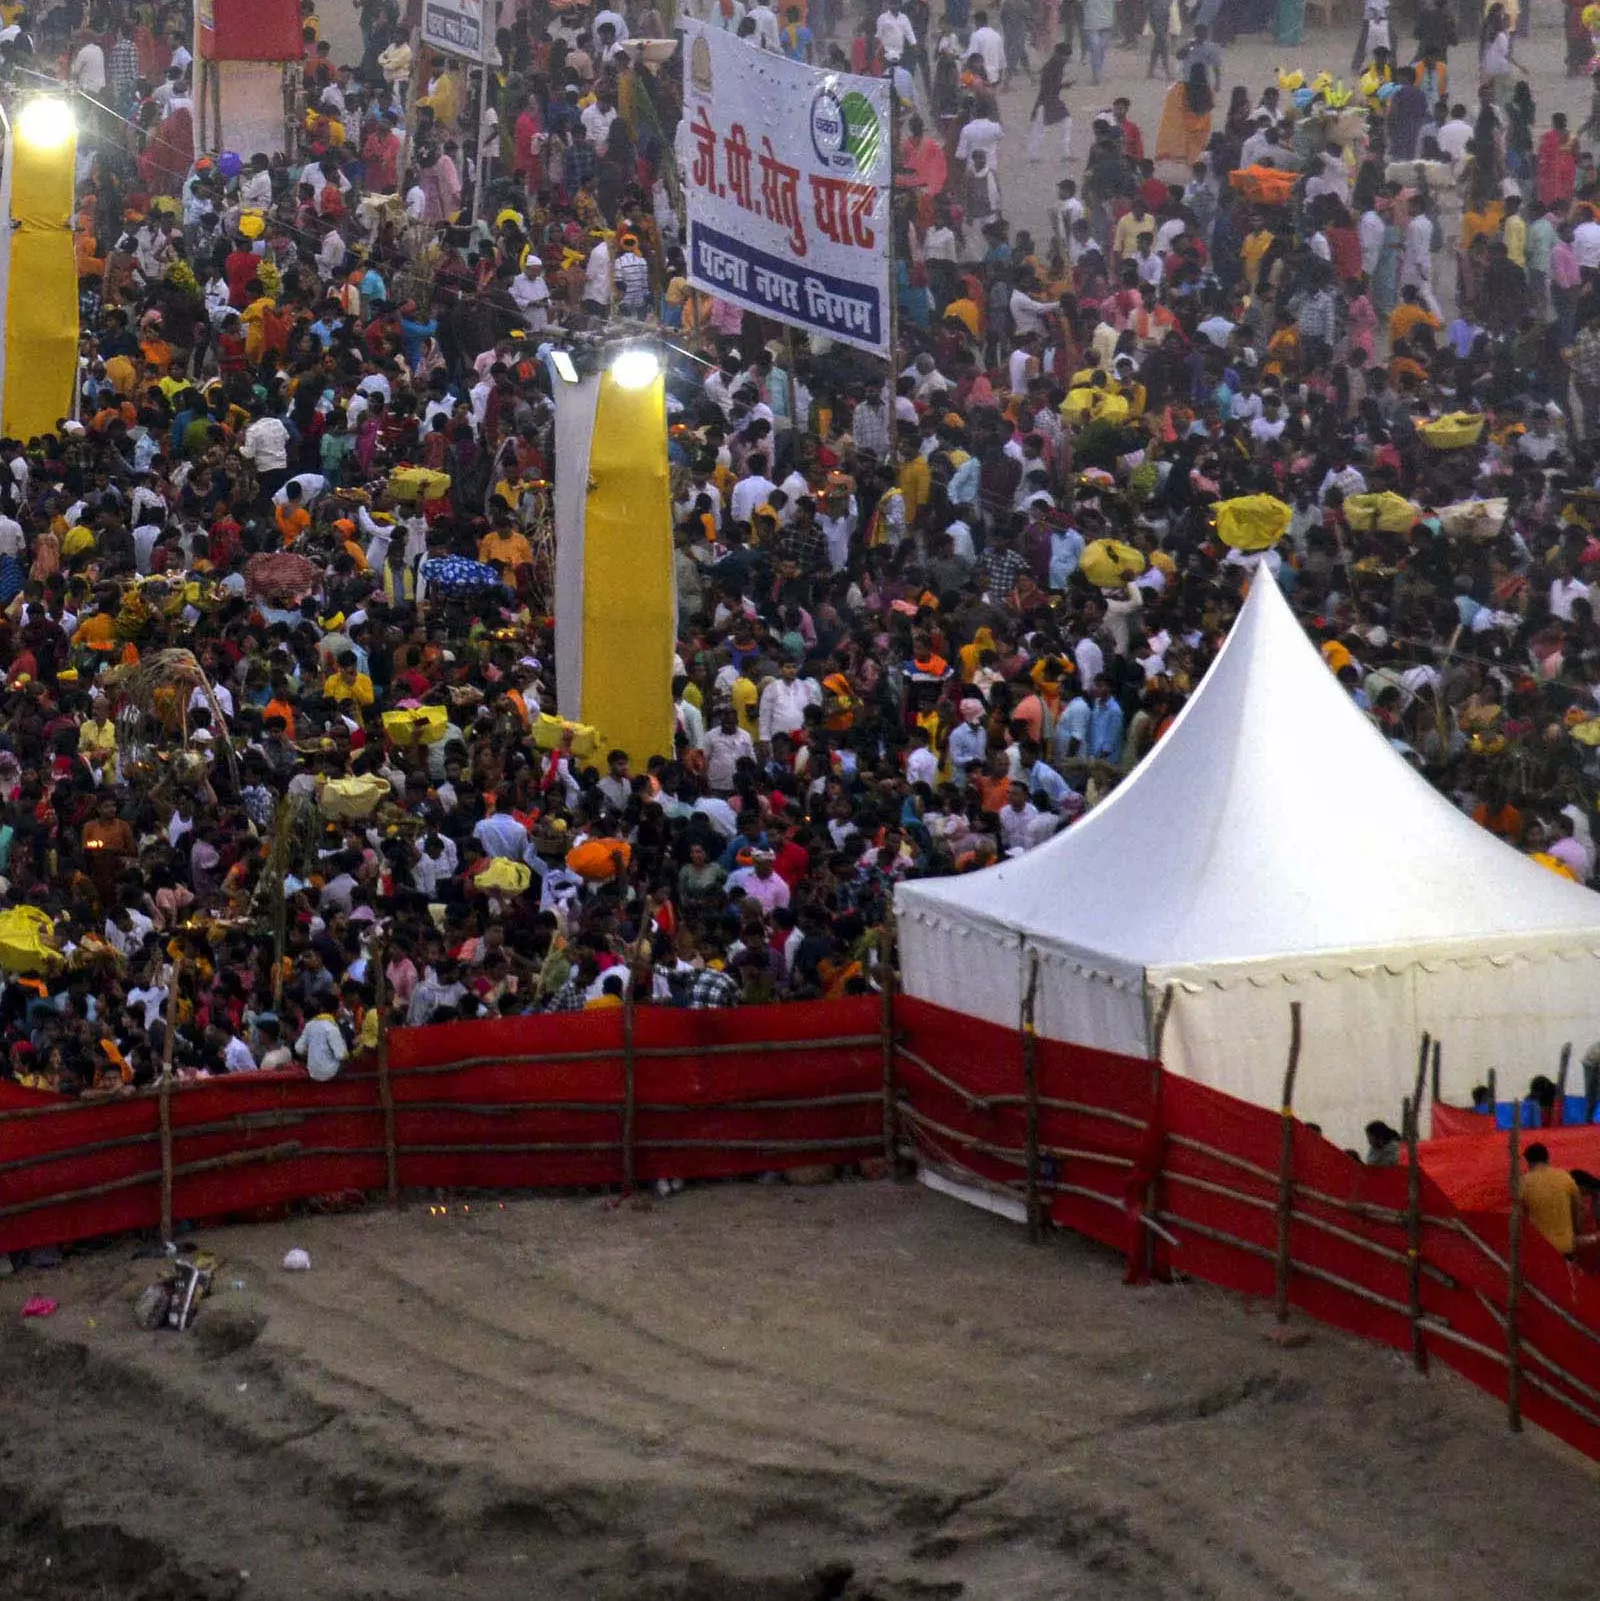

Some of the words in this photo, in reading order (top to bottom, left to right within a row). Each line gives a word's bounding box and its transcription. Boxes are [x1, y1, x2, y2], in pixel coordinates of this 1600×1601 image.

[808, 173, 877, 249] घाट
[698, 240, 749, 293] पटना
[753, 266, 800, 313] नगर
[803, 277, 873, 335] निगम
